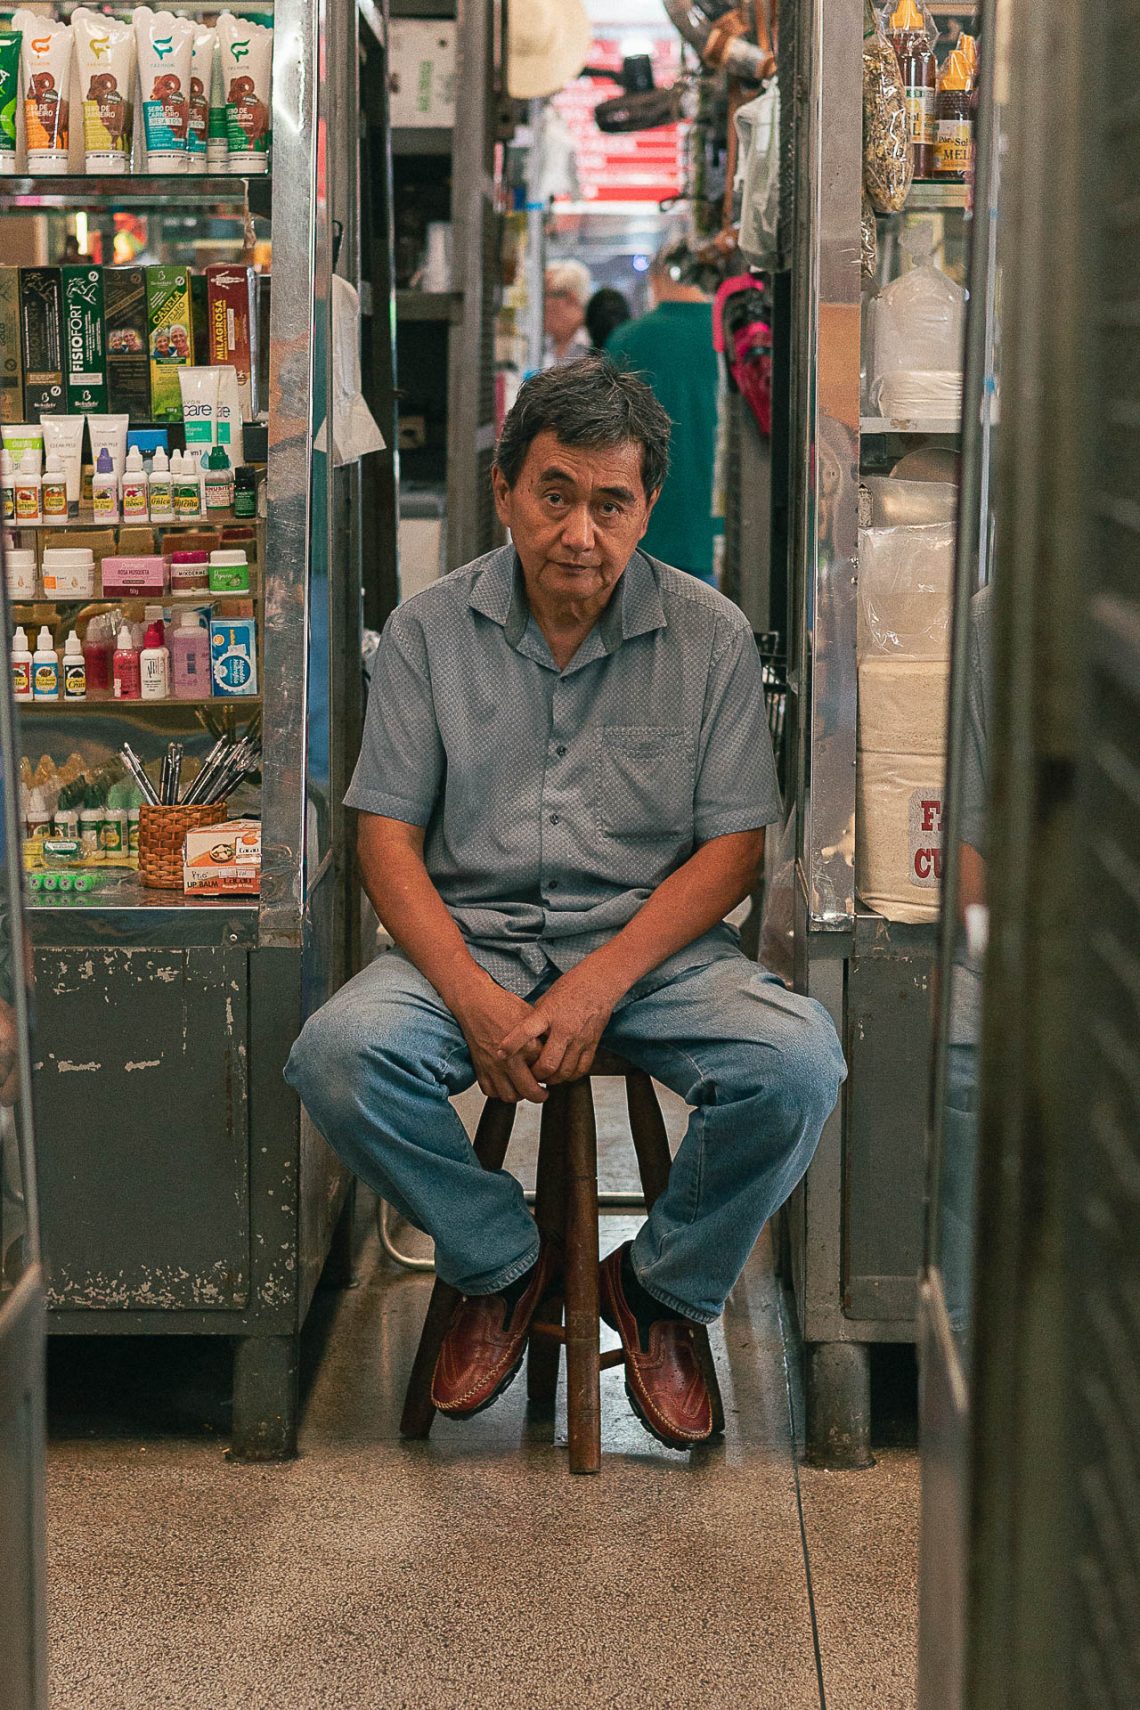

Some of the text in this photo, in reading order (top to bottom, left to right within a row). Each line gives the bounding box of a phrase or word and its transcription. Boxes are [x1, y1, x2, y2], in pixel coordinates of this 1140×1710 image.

[152, 290, 184, 325] CANELA
[215, 299, 226, 360] MILAGROSA
[70, 304, 84, 372] FISIOFORT
[183, 404, 213, 417] care
